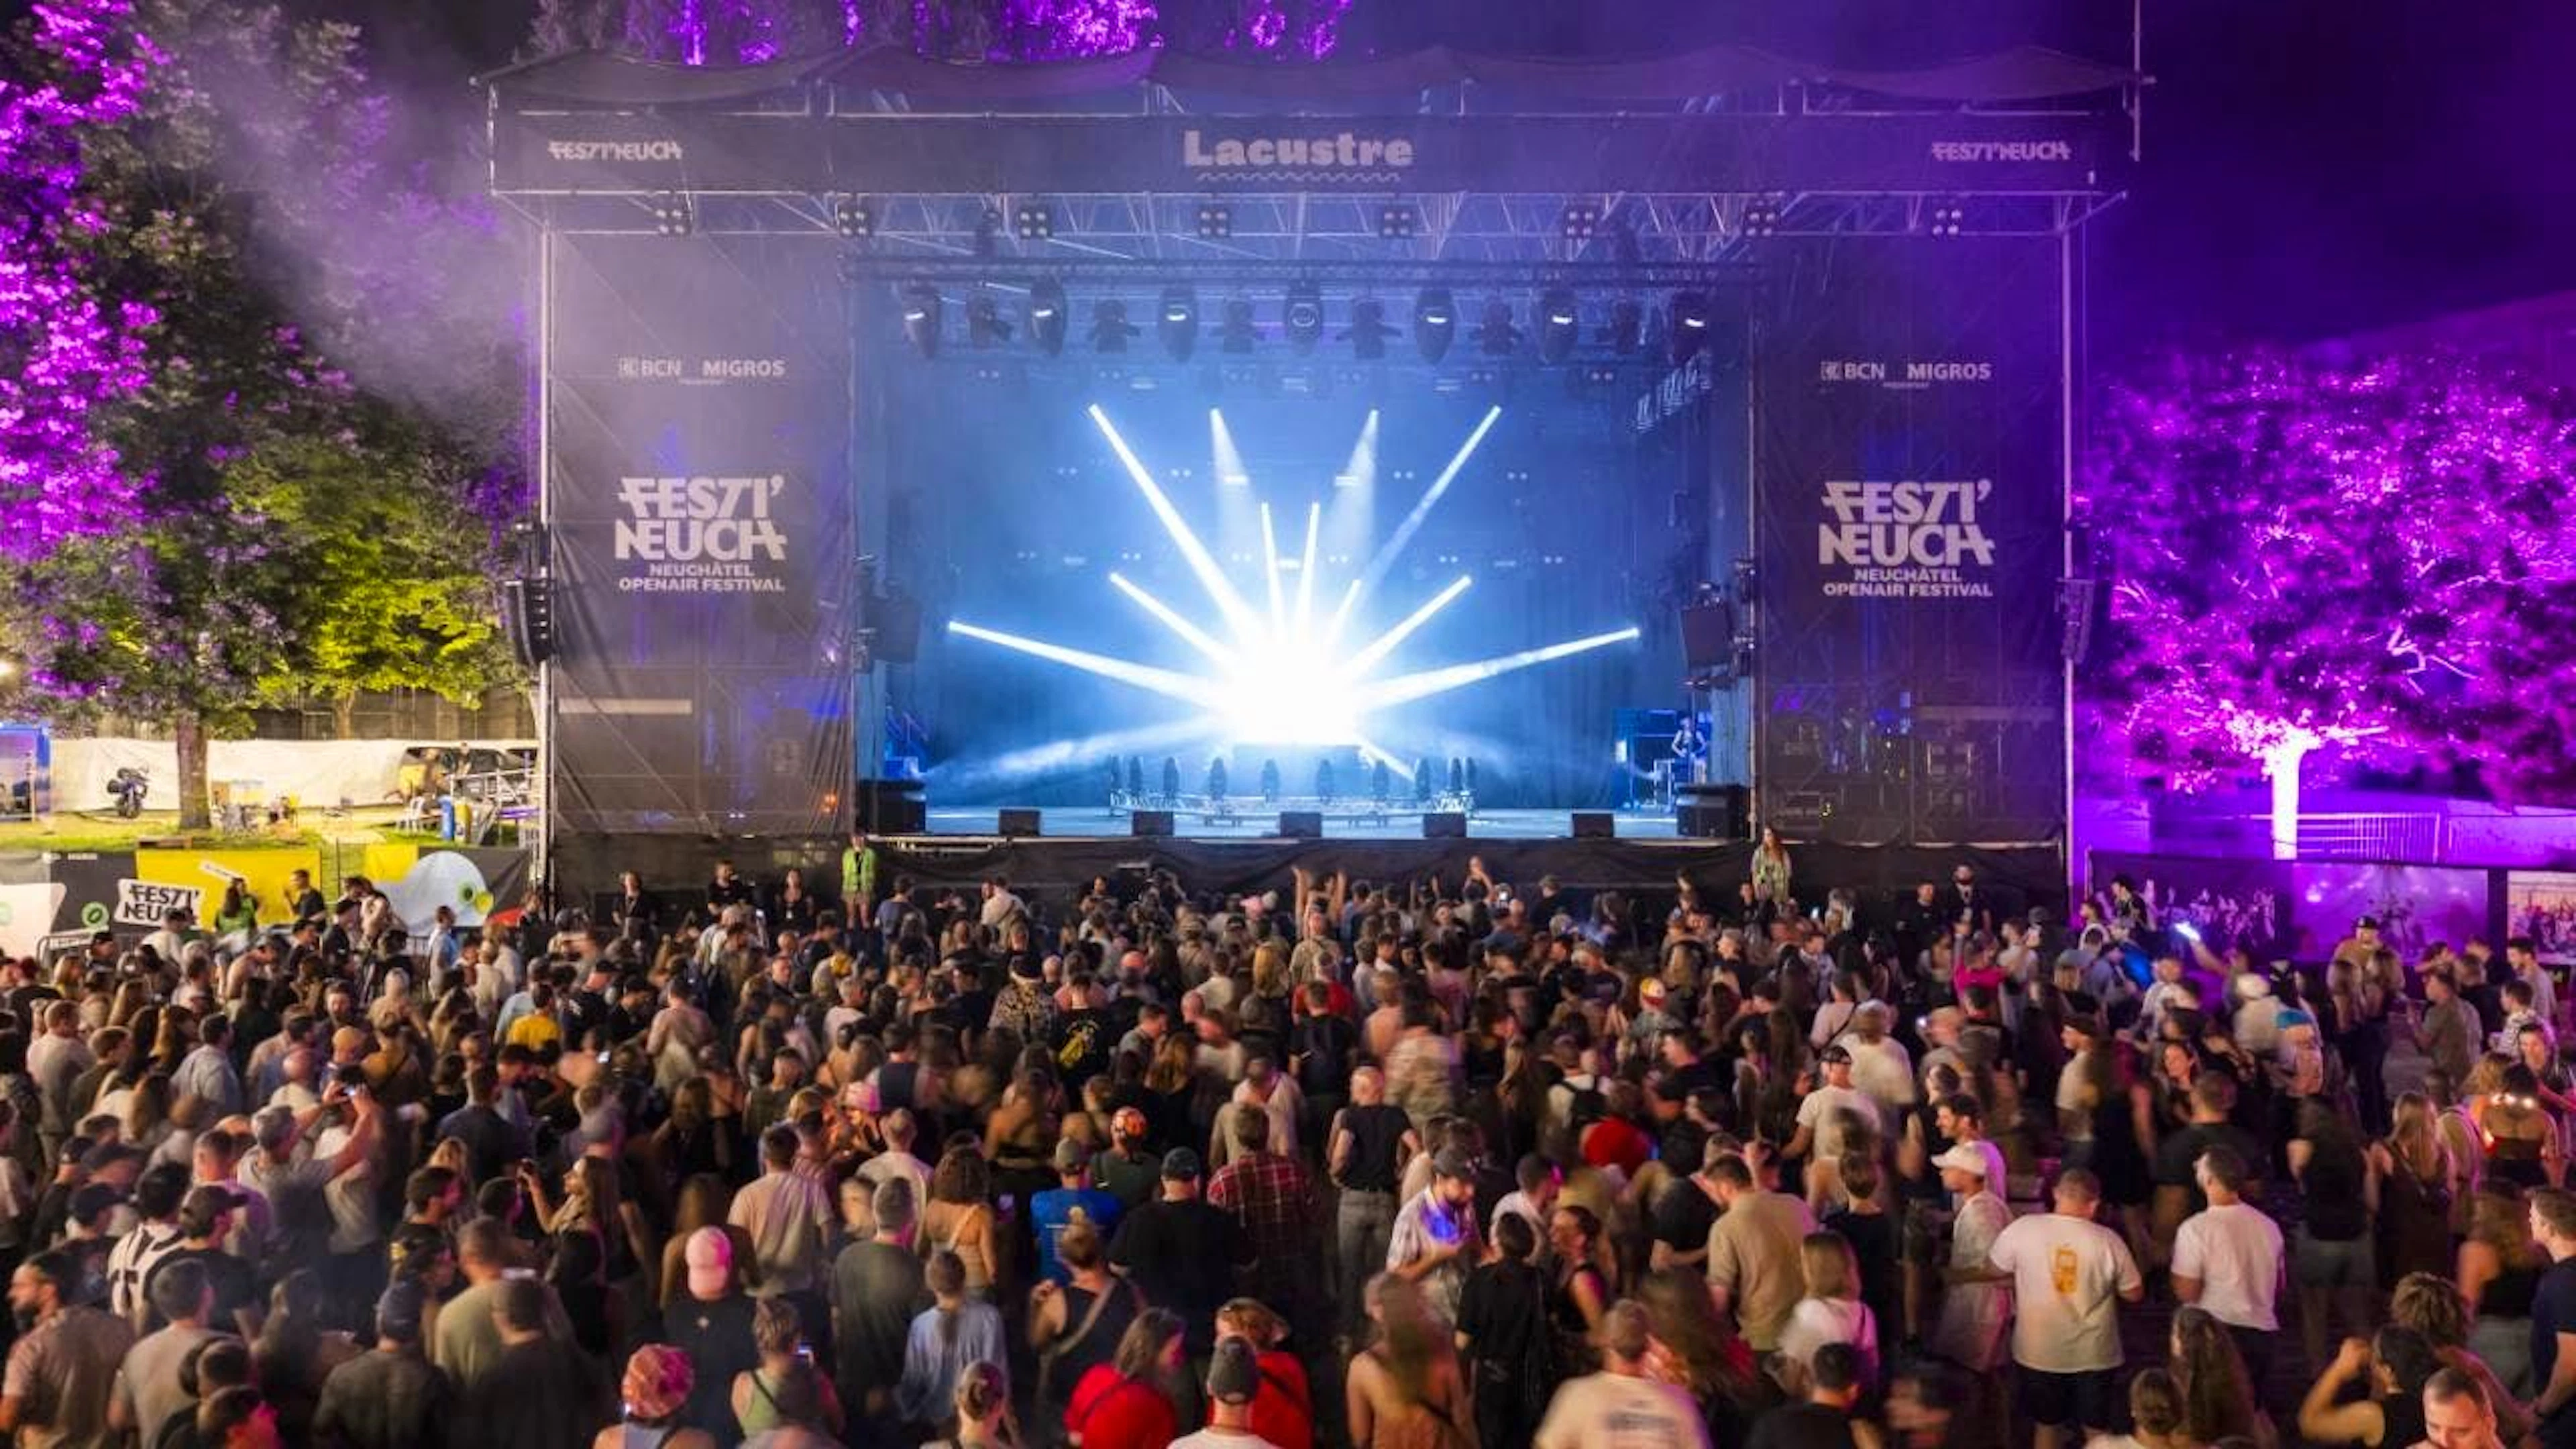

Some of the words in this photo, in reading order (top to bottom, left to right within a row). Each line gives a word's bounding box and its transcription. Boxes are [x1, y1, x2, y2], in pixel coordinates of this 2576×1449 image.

[1183, 129, 1413, 167] Lacustre
[641, 360, 682, 377] BCN
[703, 360, 786, 377] MIGROS
[1844, 363, 1885, 380] BCN
[1907, 363, 1992, 380] MIGROS
[618, 474, 784, 519] FESTI'
[1821, 478, 1992, 523] FESTI'
[615, 519, 788, 561] NEUCH
[1819, 523, 1996, 567] NEUCH
[649, 562, 755, 577] NEUCHÂTEL
[1854, 567, 1963, 582] NEUCHÂTEL
[619, 578, 700, 591] OPENAIR
[702, 578, 786, 591] FESTIVAL
[1823, 582, 1906, 596] OPENAIR
[1909, 582, 1994, 596] FESTIVAL
